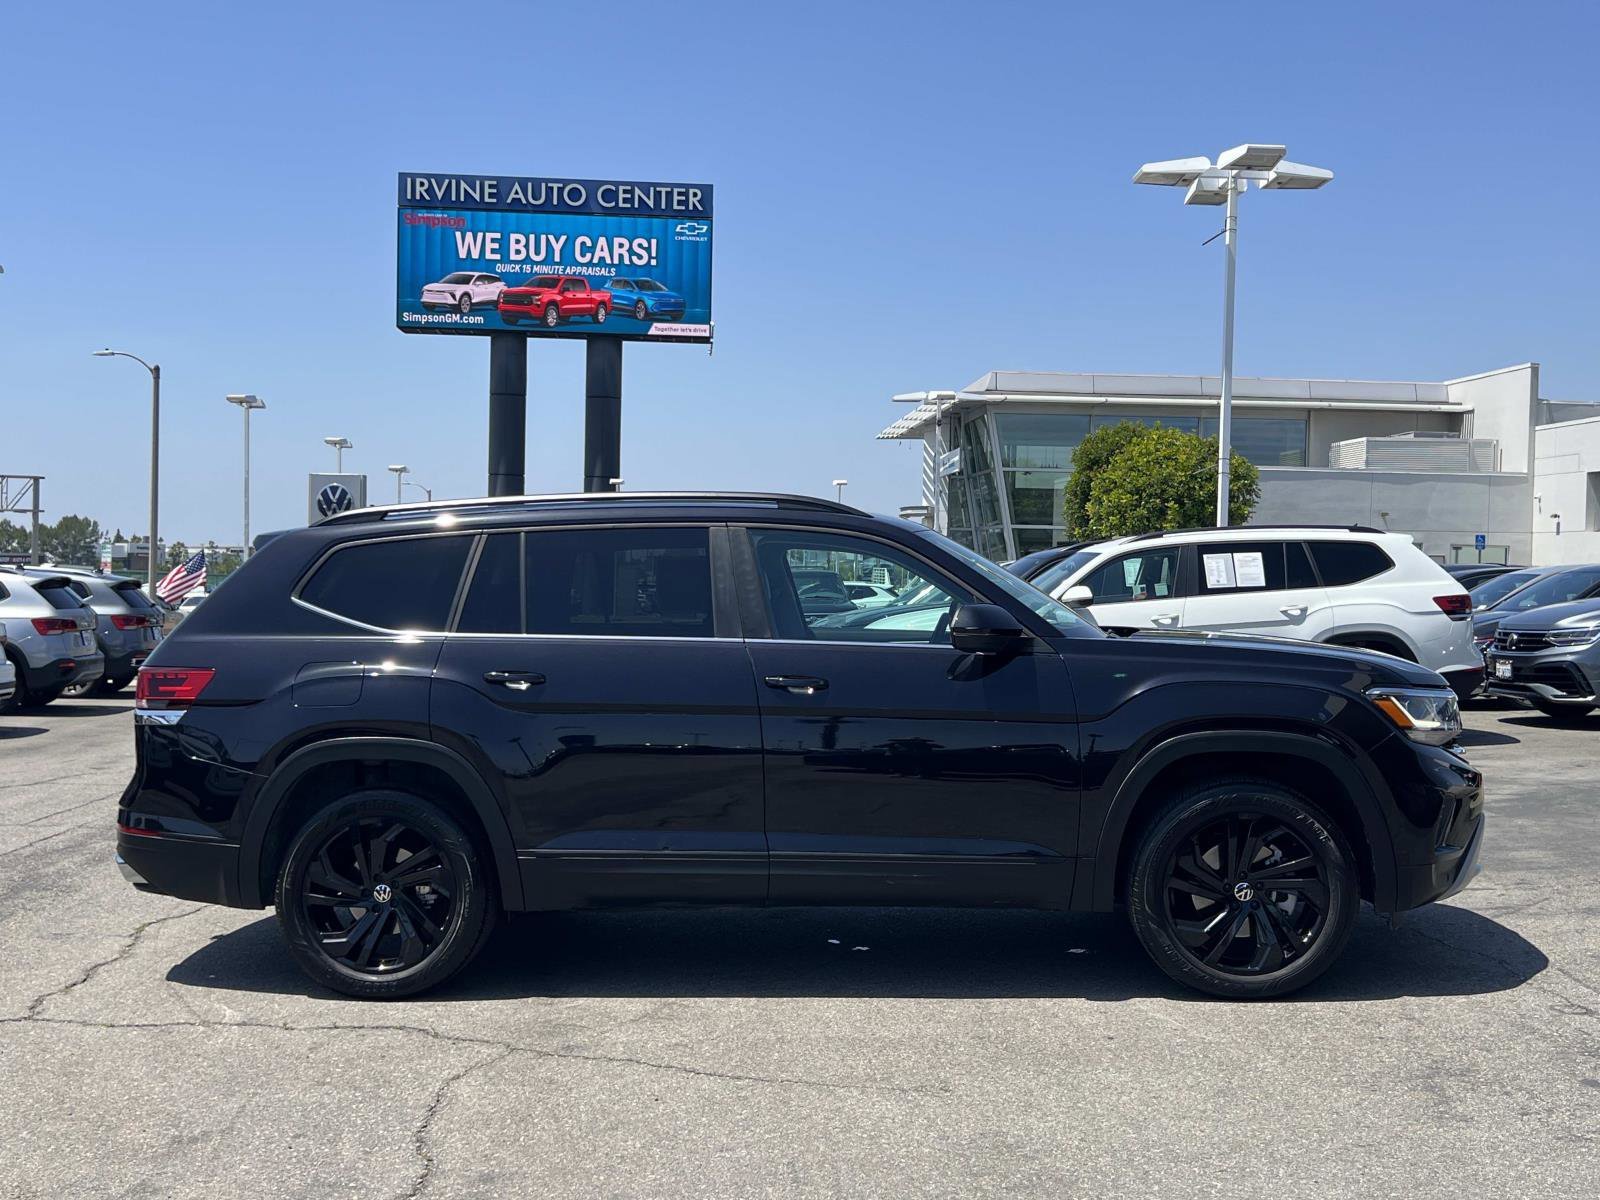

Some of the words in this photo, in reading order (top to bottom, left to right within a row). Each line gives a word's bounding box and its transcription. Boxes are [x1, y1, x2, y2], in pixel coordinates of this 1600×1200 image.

[406, 177, 497, 203] IRVINE
[506, 181, 587, 207] AUTO
[597, 184, 704, 211] CENTER
[403, 212, 466, 229] Simpson
[455, 231, 501, 260] WE
[509, 233, 568, 262] BUY
[574, 235, 658, 266] CARS!
[495, 263, 521, 273] QUICK
[522, 265, 531, 274] 15
[532, 265, 565, 275] MINUTE
[565, 266, 616, 276] APPRAISALS
[402, 312, 484, 324] SimpsonGM.com
